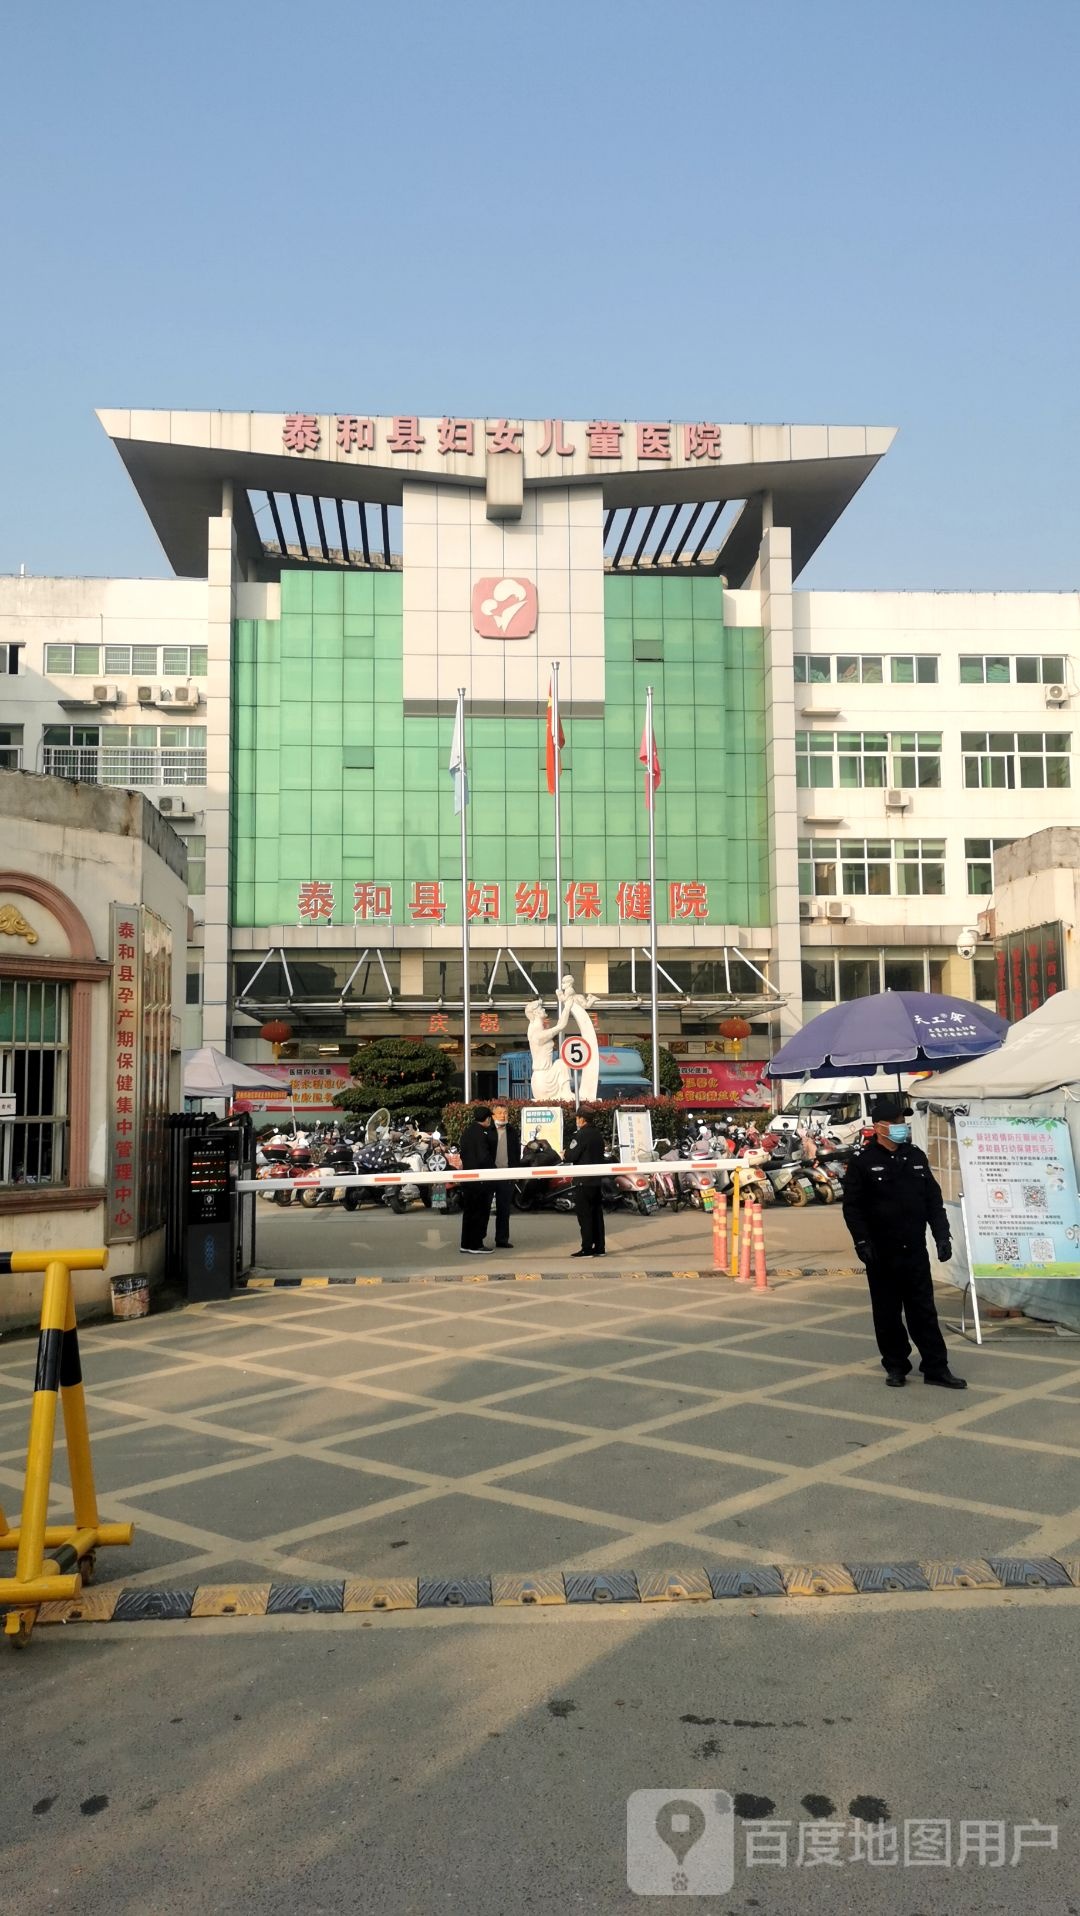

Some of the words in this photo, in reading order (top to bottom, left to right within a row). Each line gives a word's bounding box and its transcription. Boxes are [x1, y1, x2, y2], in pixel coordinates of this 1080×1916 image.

[281, 414, 722, 459] 泰和县妇女儿童医院
[297, 880, 709, 920] 泰和县妇幼保健院
[571, 1043, 583, 1063] 5
[115, 922, 135, 1228] 泰和县孕产期保健集中管理中心
